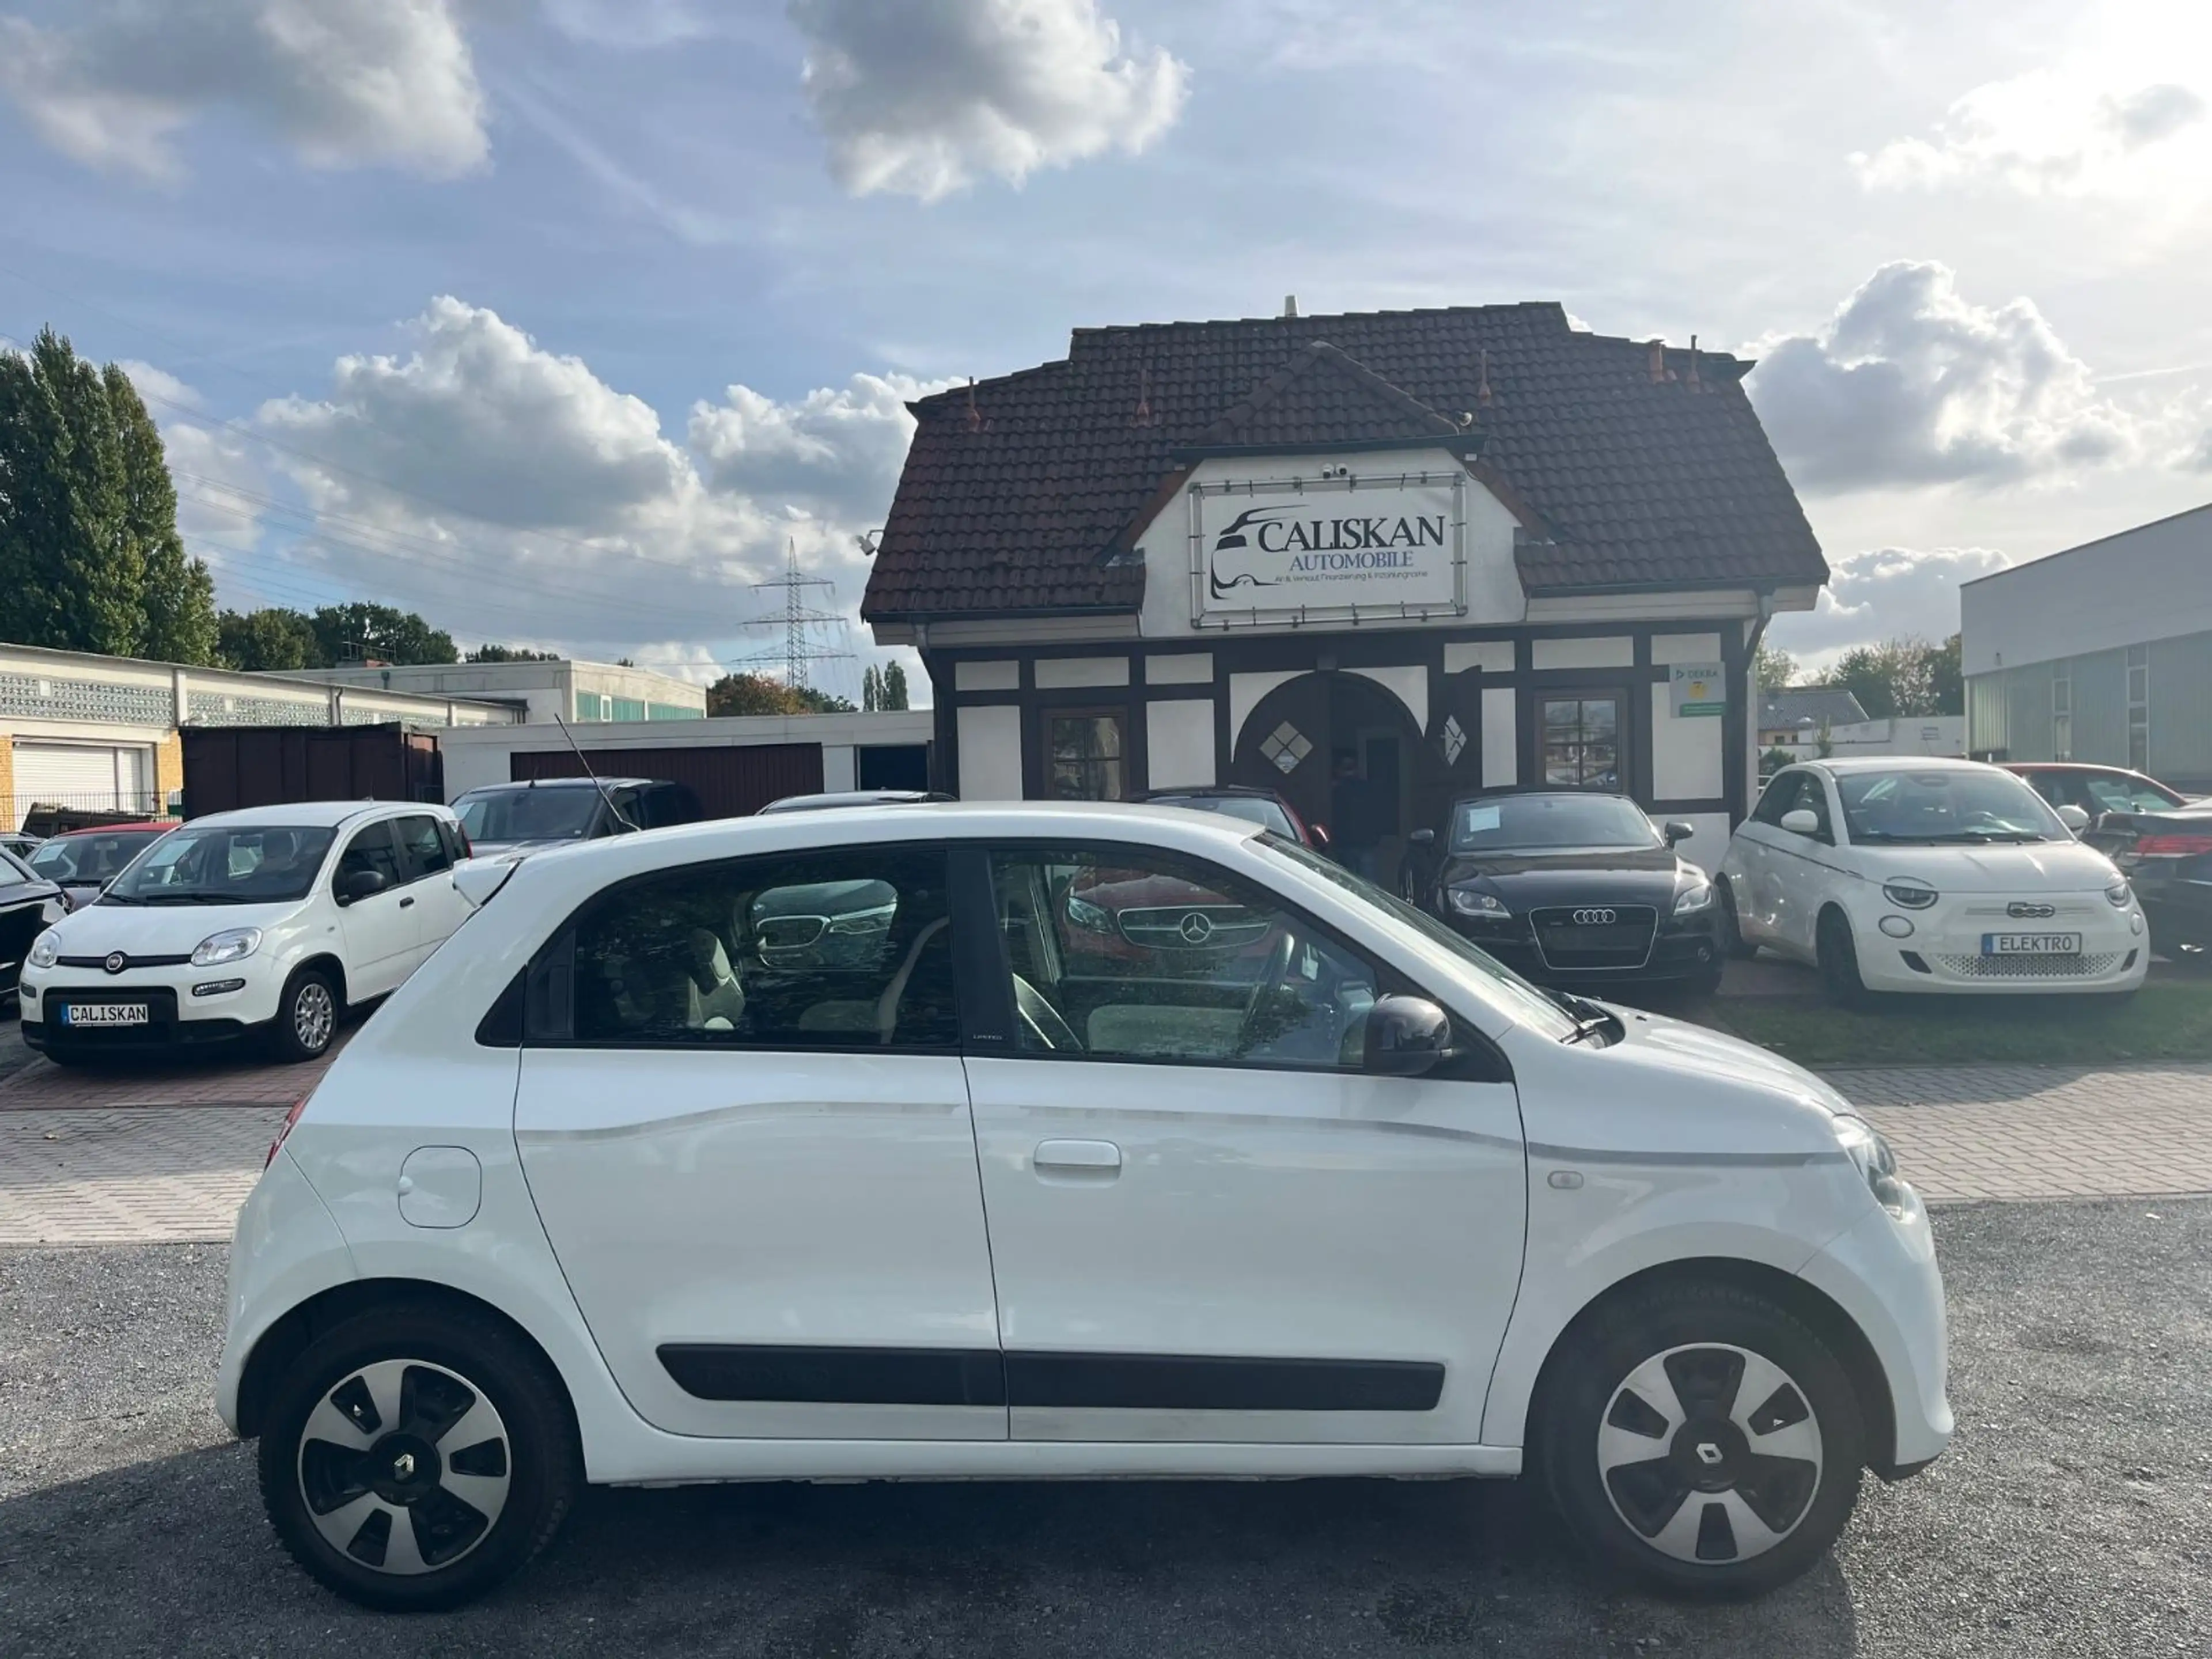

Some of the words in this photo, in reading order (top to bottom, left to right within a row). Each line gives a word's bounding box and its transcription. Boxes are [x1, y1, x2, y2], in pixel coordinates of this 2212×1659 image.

[1257, 515, 1445, 552] CALISKAN
[1290, 551, 1414, 571] AUTOMOBILE
[1999, 935, 2073, 951] ELEKTRO
[70, 1006, 146, 1021] CALISKAN
